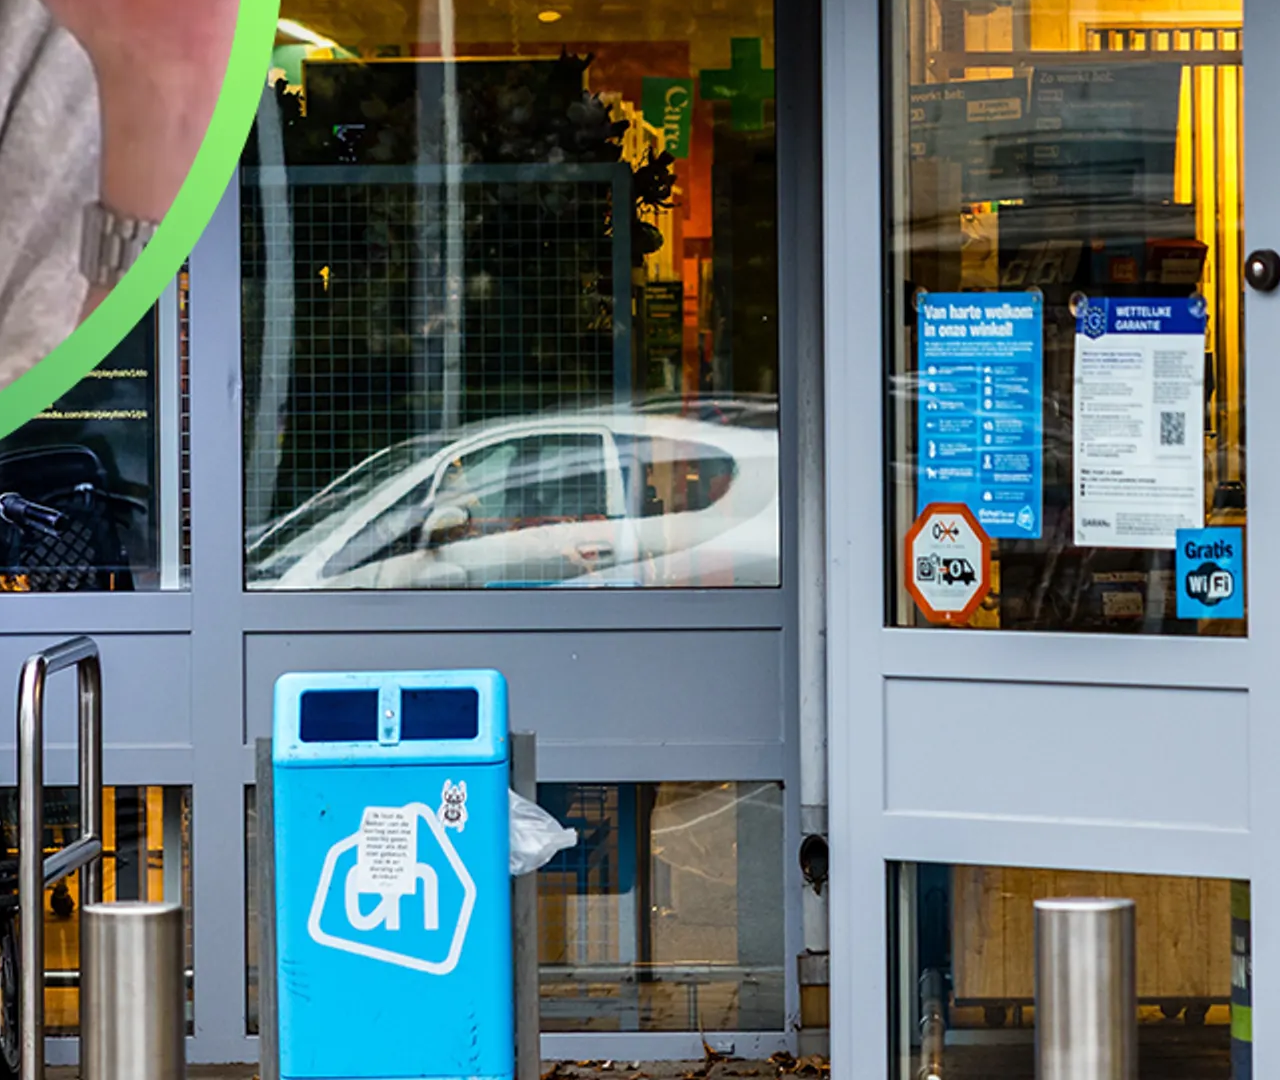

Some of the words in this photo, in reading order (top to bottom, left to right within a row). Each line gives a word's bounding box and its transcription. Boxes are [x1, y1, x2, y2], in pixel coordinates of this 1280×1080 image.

[923, 304, 947, 320] Van
[949, 303, 982, 320] harte
[983, 303, 1033, 320] welkom
[1115, 305, 1172, 318] WETTELIJKE
[938, 324, 967, 337] onze
[1114, 319, 1161, 331] GARANTIE
[1184, 539, 1234, 560] Gratis
